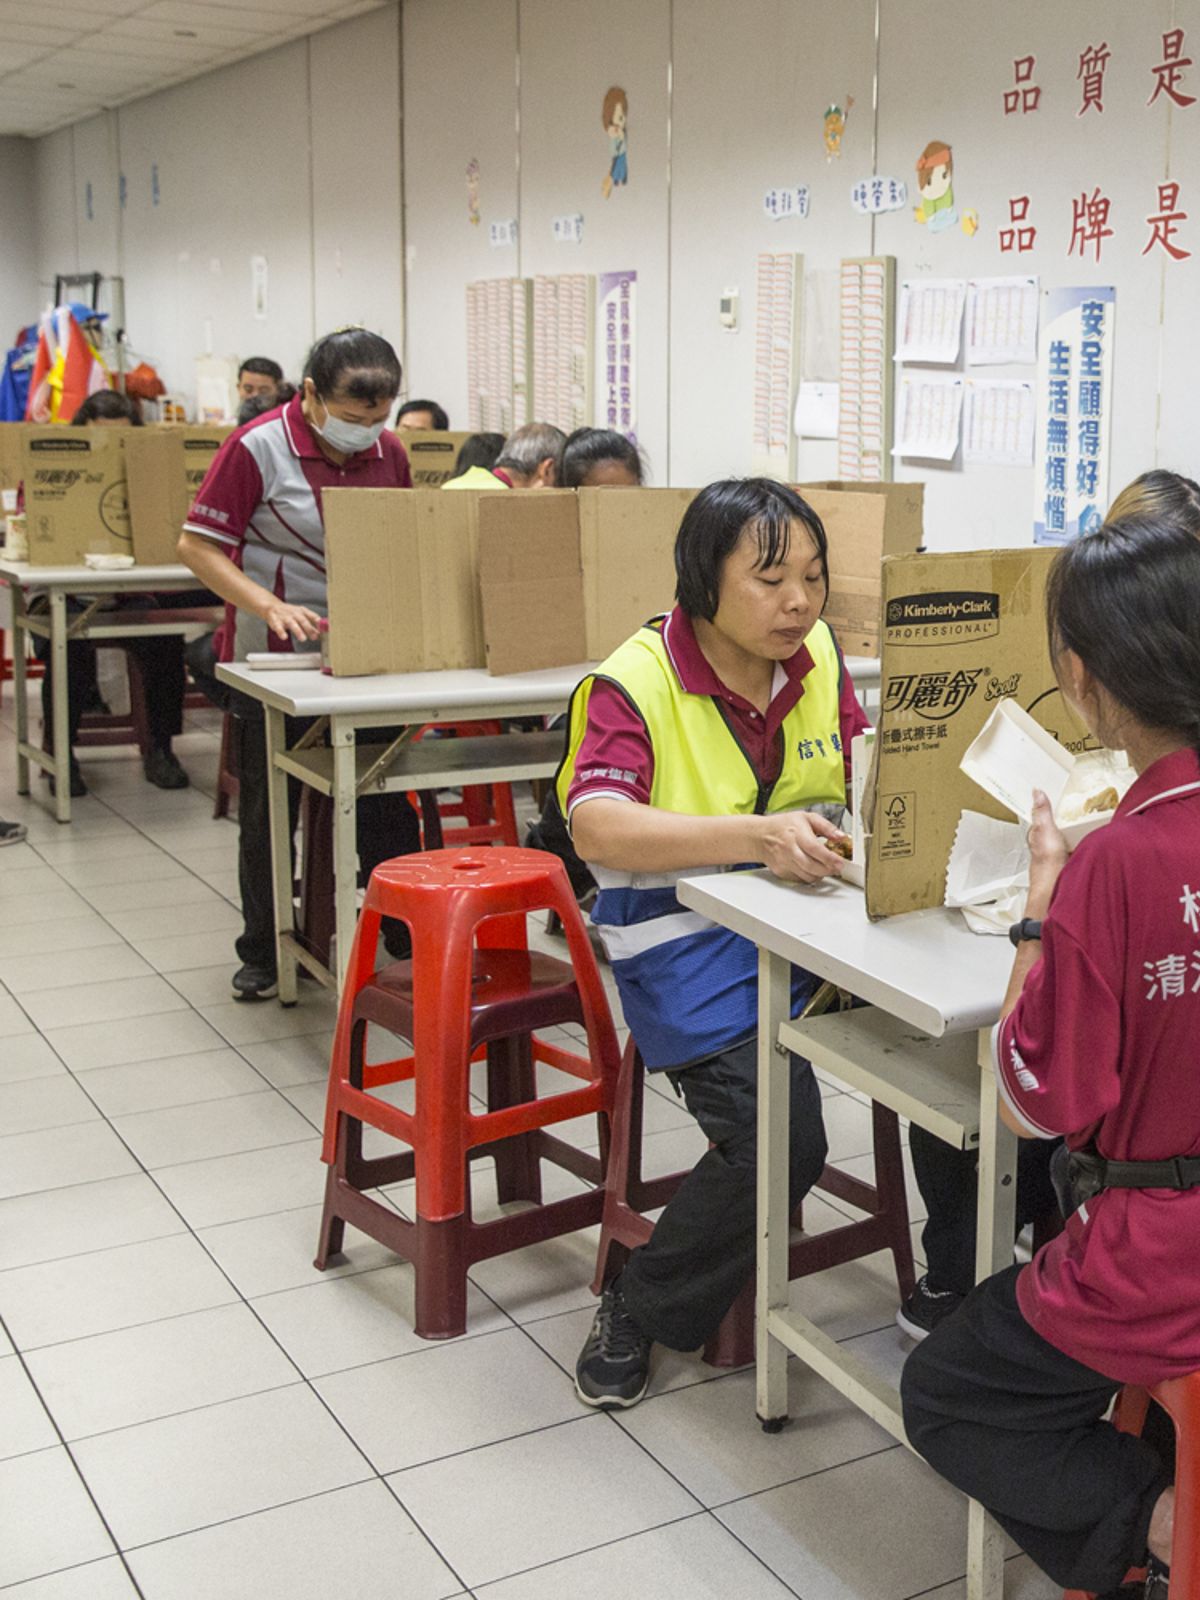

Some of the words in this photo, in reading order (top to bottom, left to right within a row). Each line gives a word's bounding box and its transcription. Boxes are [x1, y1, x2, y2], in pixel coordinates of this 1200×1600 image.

[1076, 301, 1104, 496] 安全顧得好
[1044, 340, 1071, 531] 生活無煩惱
[903, 600, 991, 617] Kimberly-Clark
[887, 624, 992, 639] PROFESSIONAL
[883, 668, 983, 712] 可麗舒
